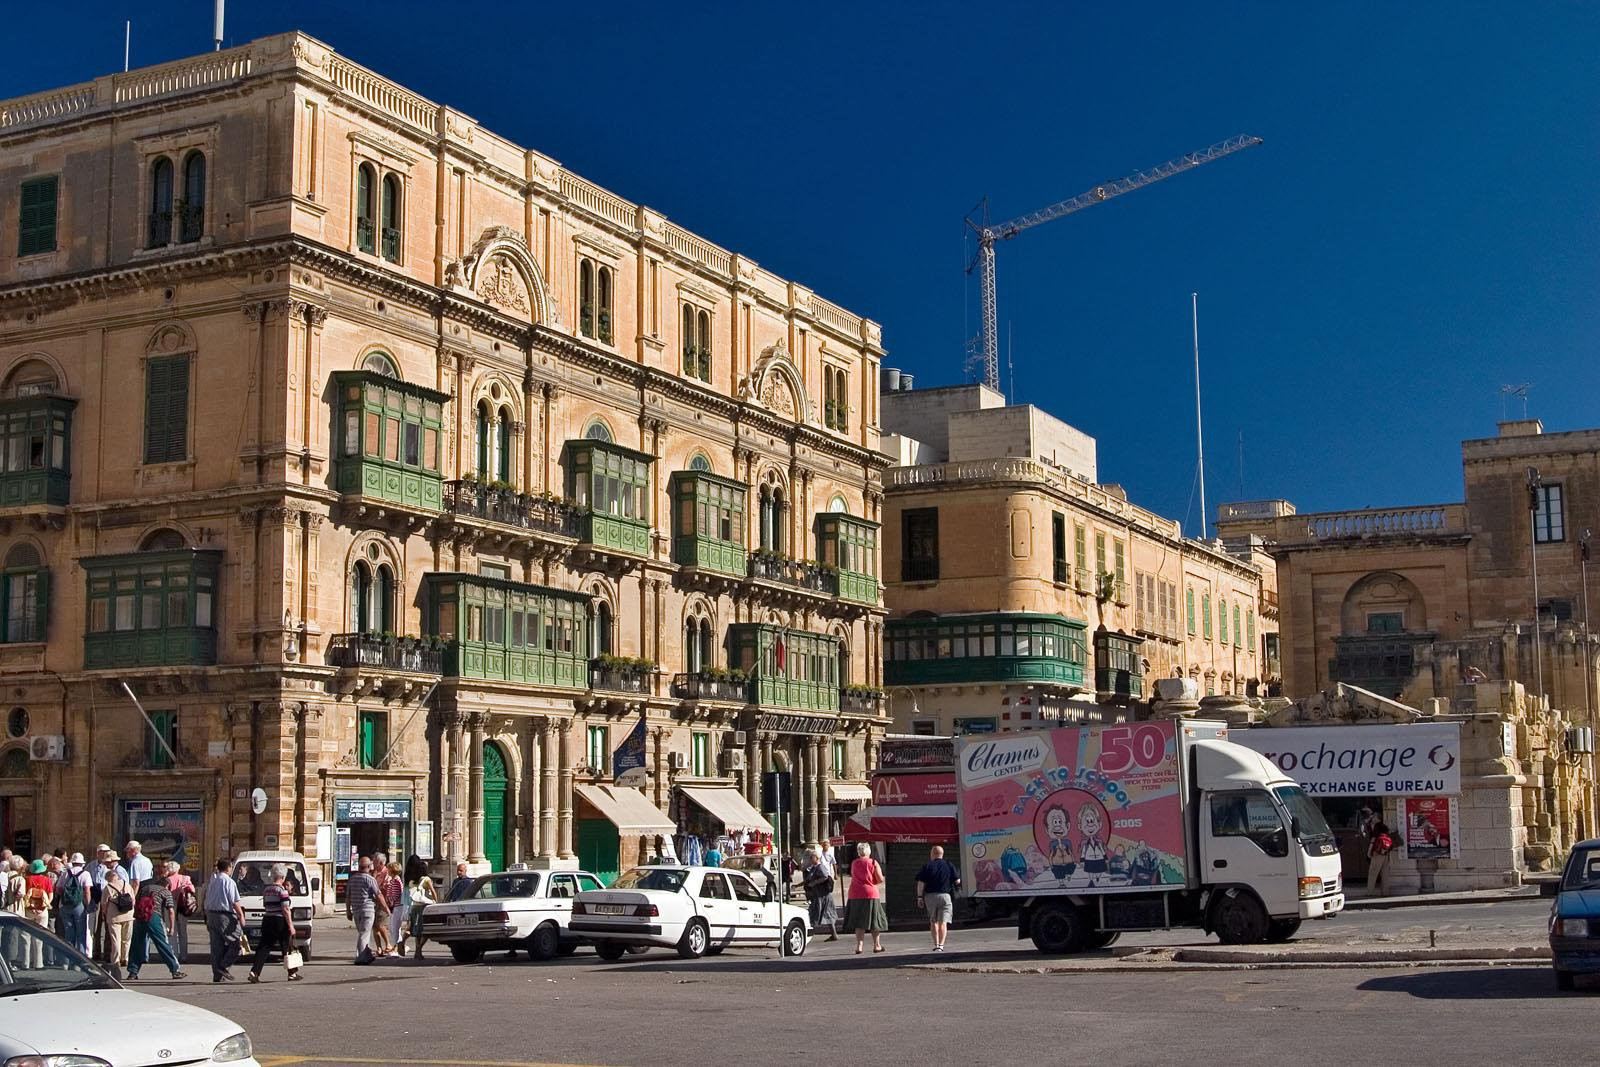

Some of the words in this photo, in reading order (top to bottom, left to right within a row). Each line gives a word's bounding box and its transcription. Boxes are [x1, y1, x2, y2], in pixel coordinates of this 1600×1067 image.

[779, 716, 809, 731] BATTA
[809, 718, 836, 733] DELIA
[1100, 725, 1165, 772] 50
[968, 743, 1039, 772] Clamus
[994, 765, 1023, 777] CENTER
[1047, 765, 1068, 781] TO
[1075, 767, 1131, 810] SCHOOL
[1302, 781, 1376, 793] EXCHANGE
[1385, 780, 1444, 792] BUREAU
[1114, 818, 1142, 829] 2005
